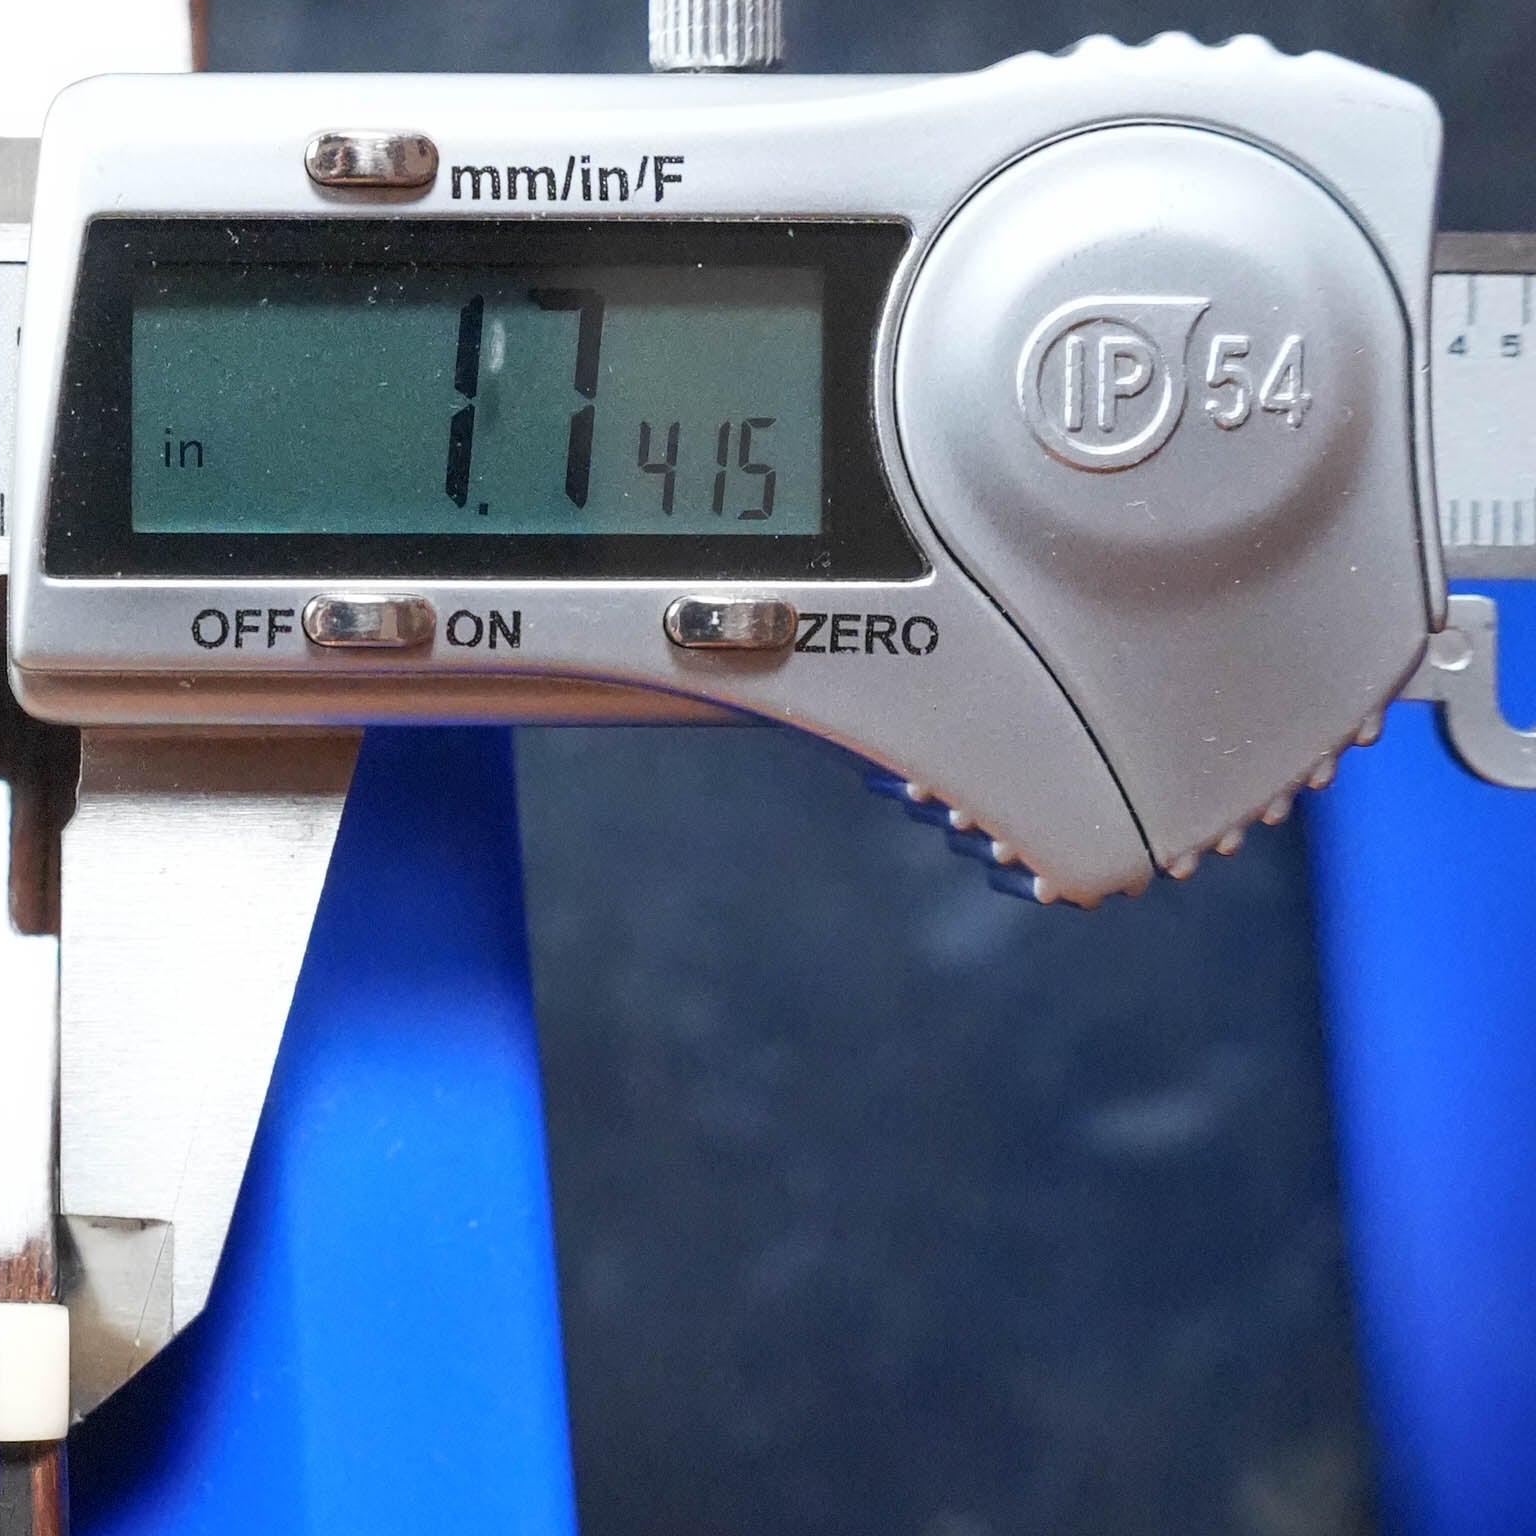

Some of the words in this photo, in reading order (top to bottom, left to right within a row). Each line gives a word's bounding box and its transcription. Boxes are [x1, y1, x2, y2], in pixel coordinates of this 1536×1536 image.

[450, 154, 685, 204] mm/in/F
[1500, 333, 1523, 359] 5
[1064, 334, 1158, 433] IP
[1204, 333, 1314, 431] 54
[164, 428, 205, 468] in
[190, 607, 296, 650] OFF
[445, 608, 522, 650] ON
[794, 610, 940, 657] ZERO
